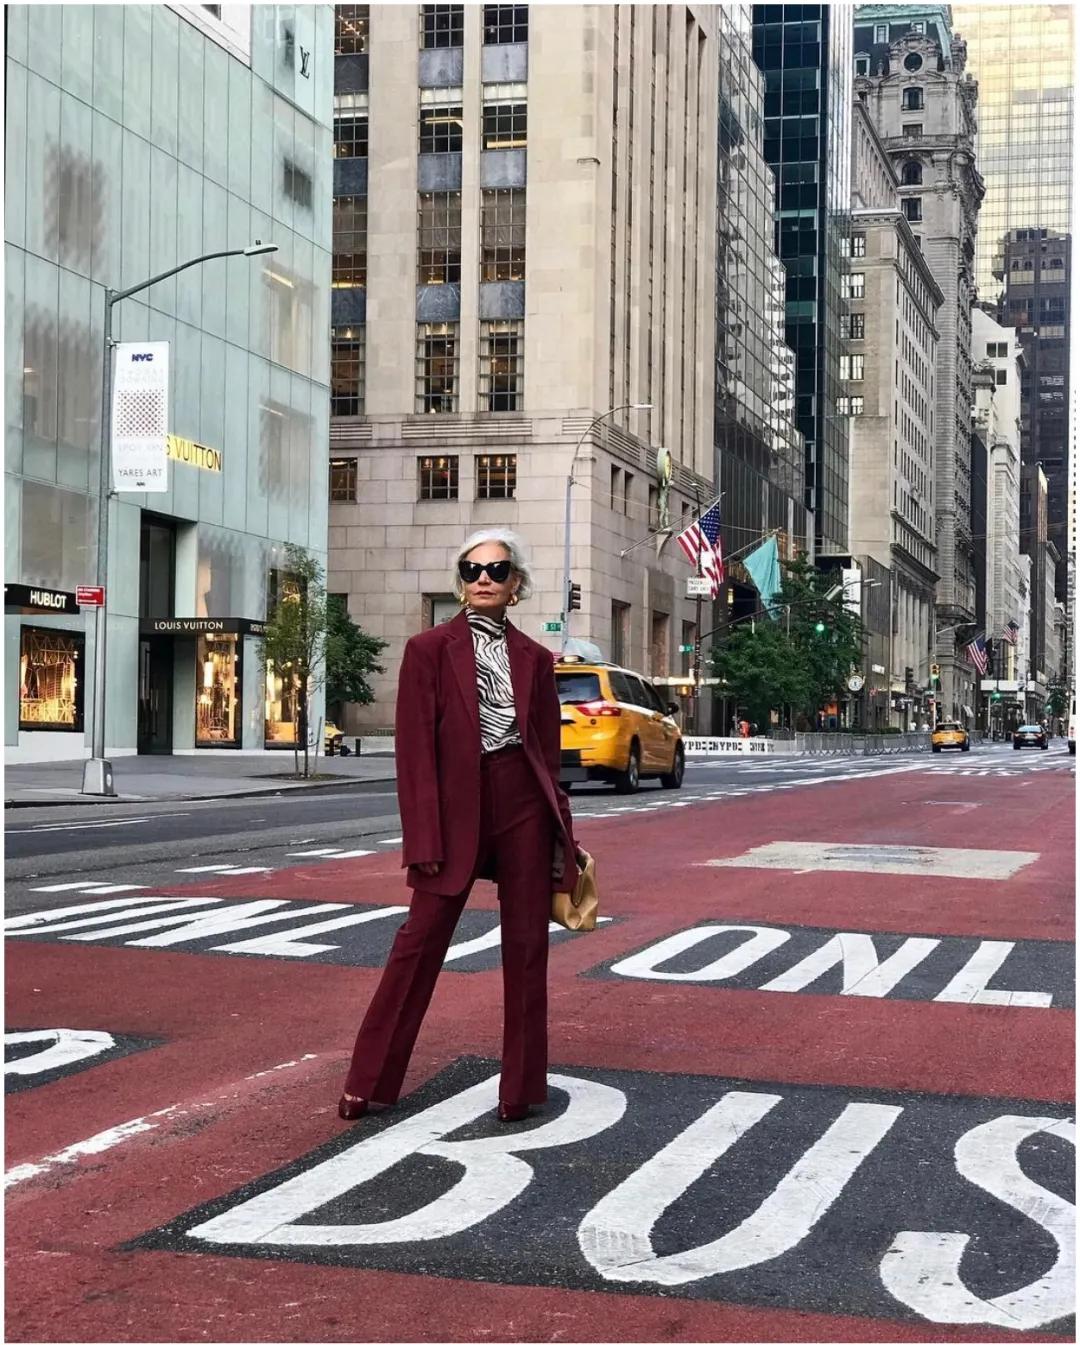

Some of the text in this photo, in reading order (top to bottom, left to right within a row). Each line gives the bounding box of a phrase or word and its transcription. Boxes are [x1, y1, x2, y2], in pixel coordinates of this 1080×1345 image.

[175, 438, 222, 470] VUITTON
[119, 468, 162, 477] YARES ART
[30, 590, 67, 608] HUBLOT
[185, 1072, 1075, 1330] BUS
